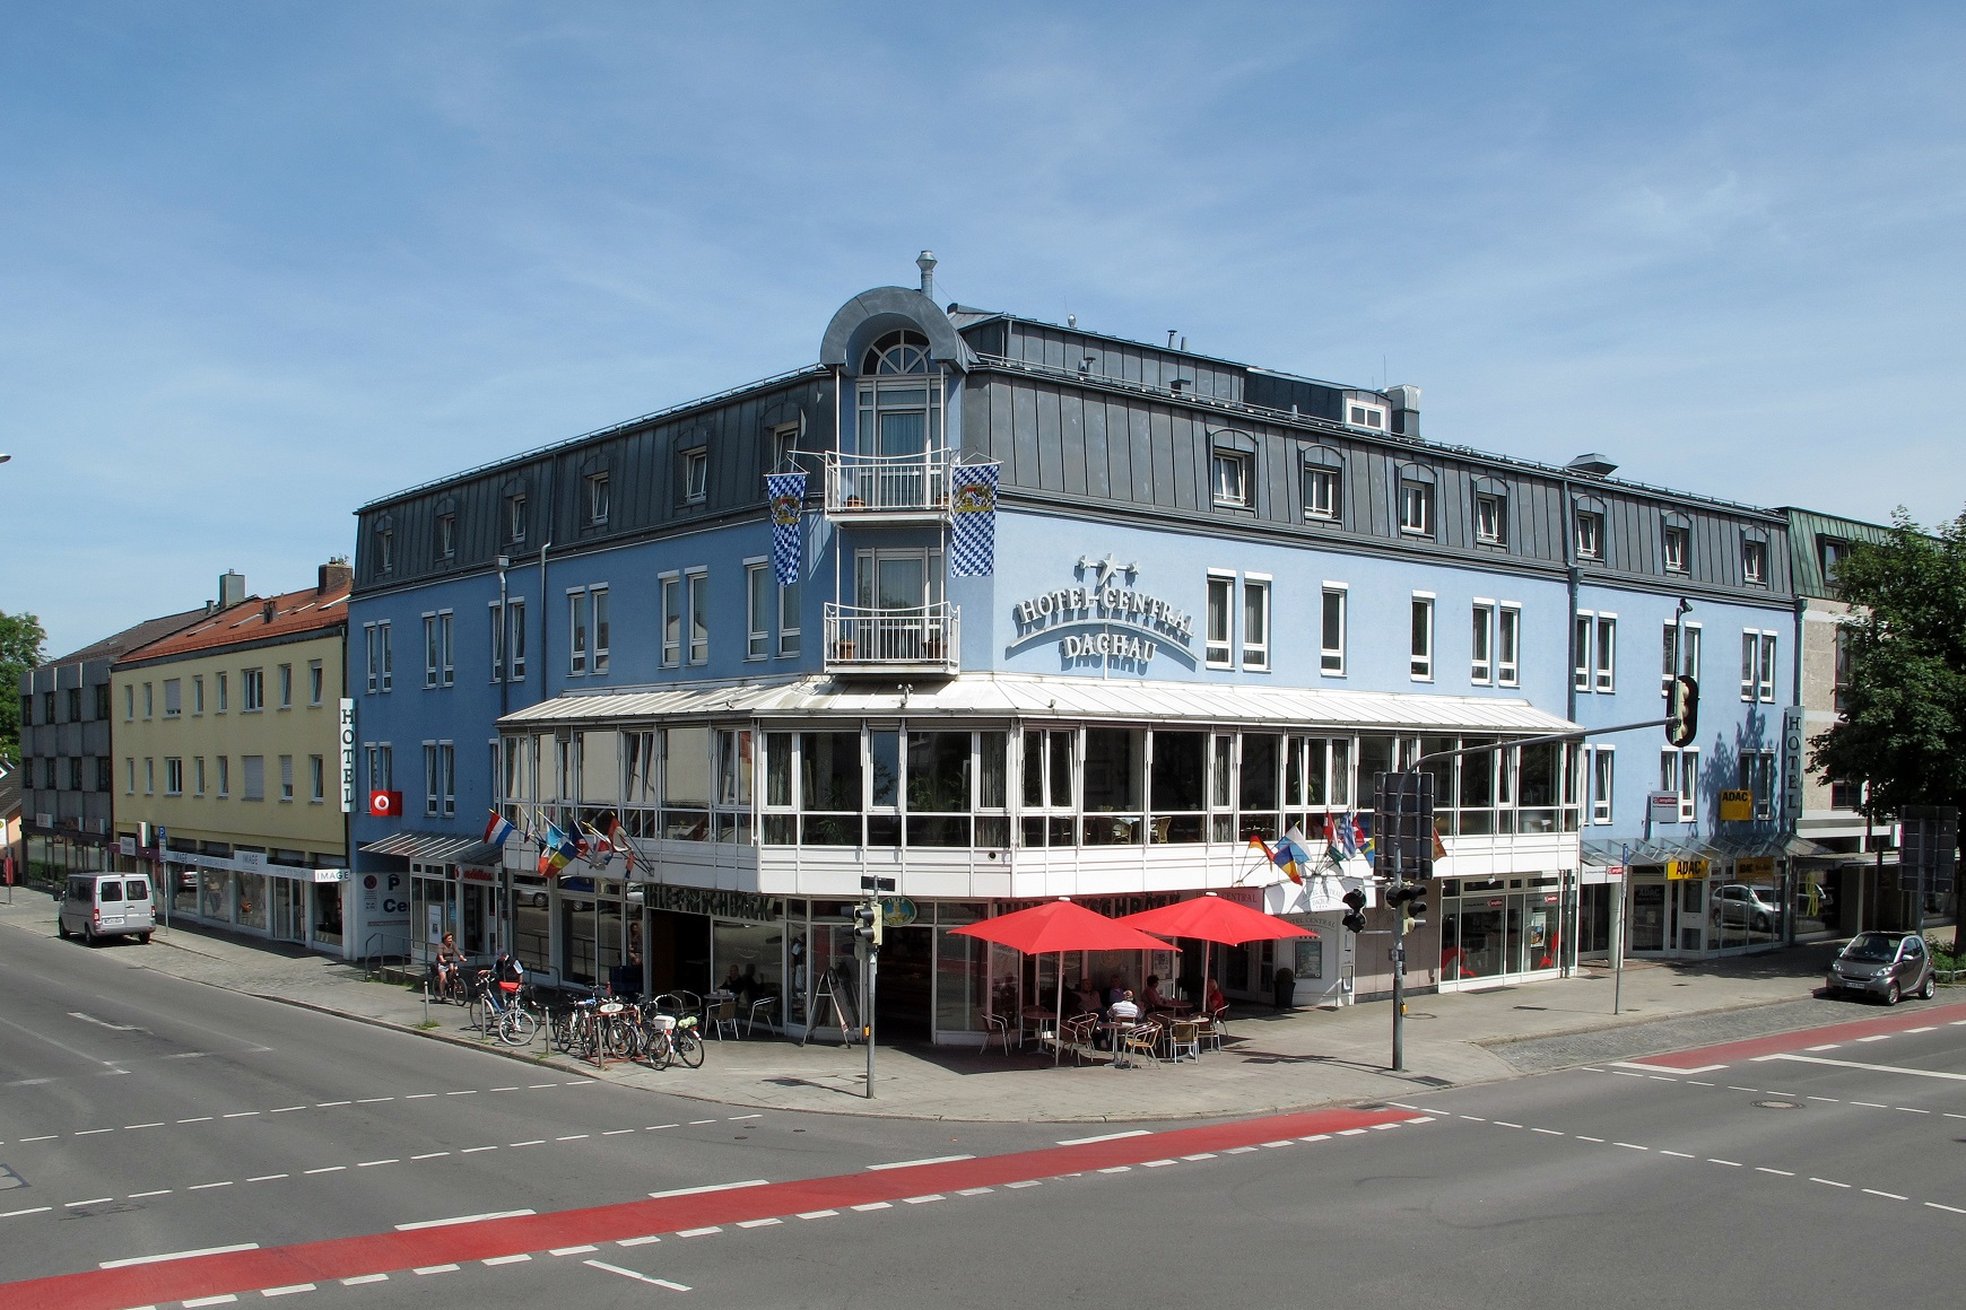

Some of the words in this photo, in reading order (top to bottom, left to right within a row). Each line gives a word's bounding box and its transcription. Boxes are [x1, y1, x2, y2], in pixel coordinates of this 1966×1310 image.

[1101, 587, 1194, 638] CENTRAL
[1063, 633, 1158, 662] DACHAU
[342, 708, 355, 804] HOTEL
[1787, 716, 1801, 809] HOTEL
[1722, 791, 1748, 802] ADAC
[242, 854, 259, 866] IMAGE
[316, 870, 349, 880] IMAGE
[1676, 861, 1701, 875] ADAC
[383, 899, 410, 913] Ce
